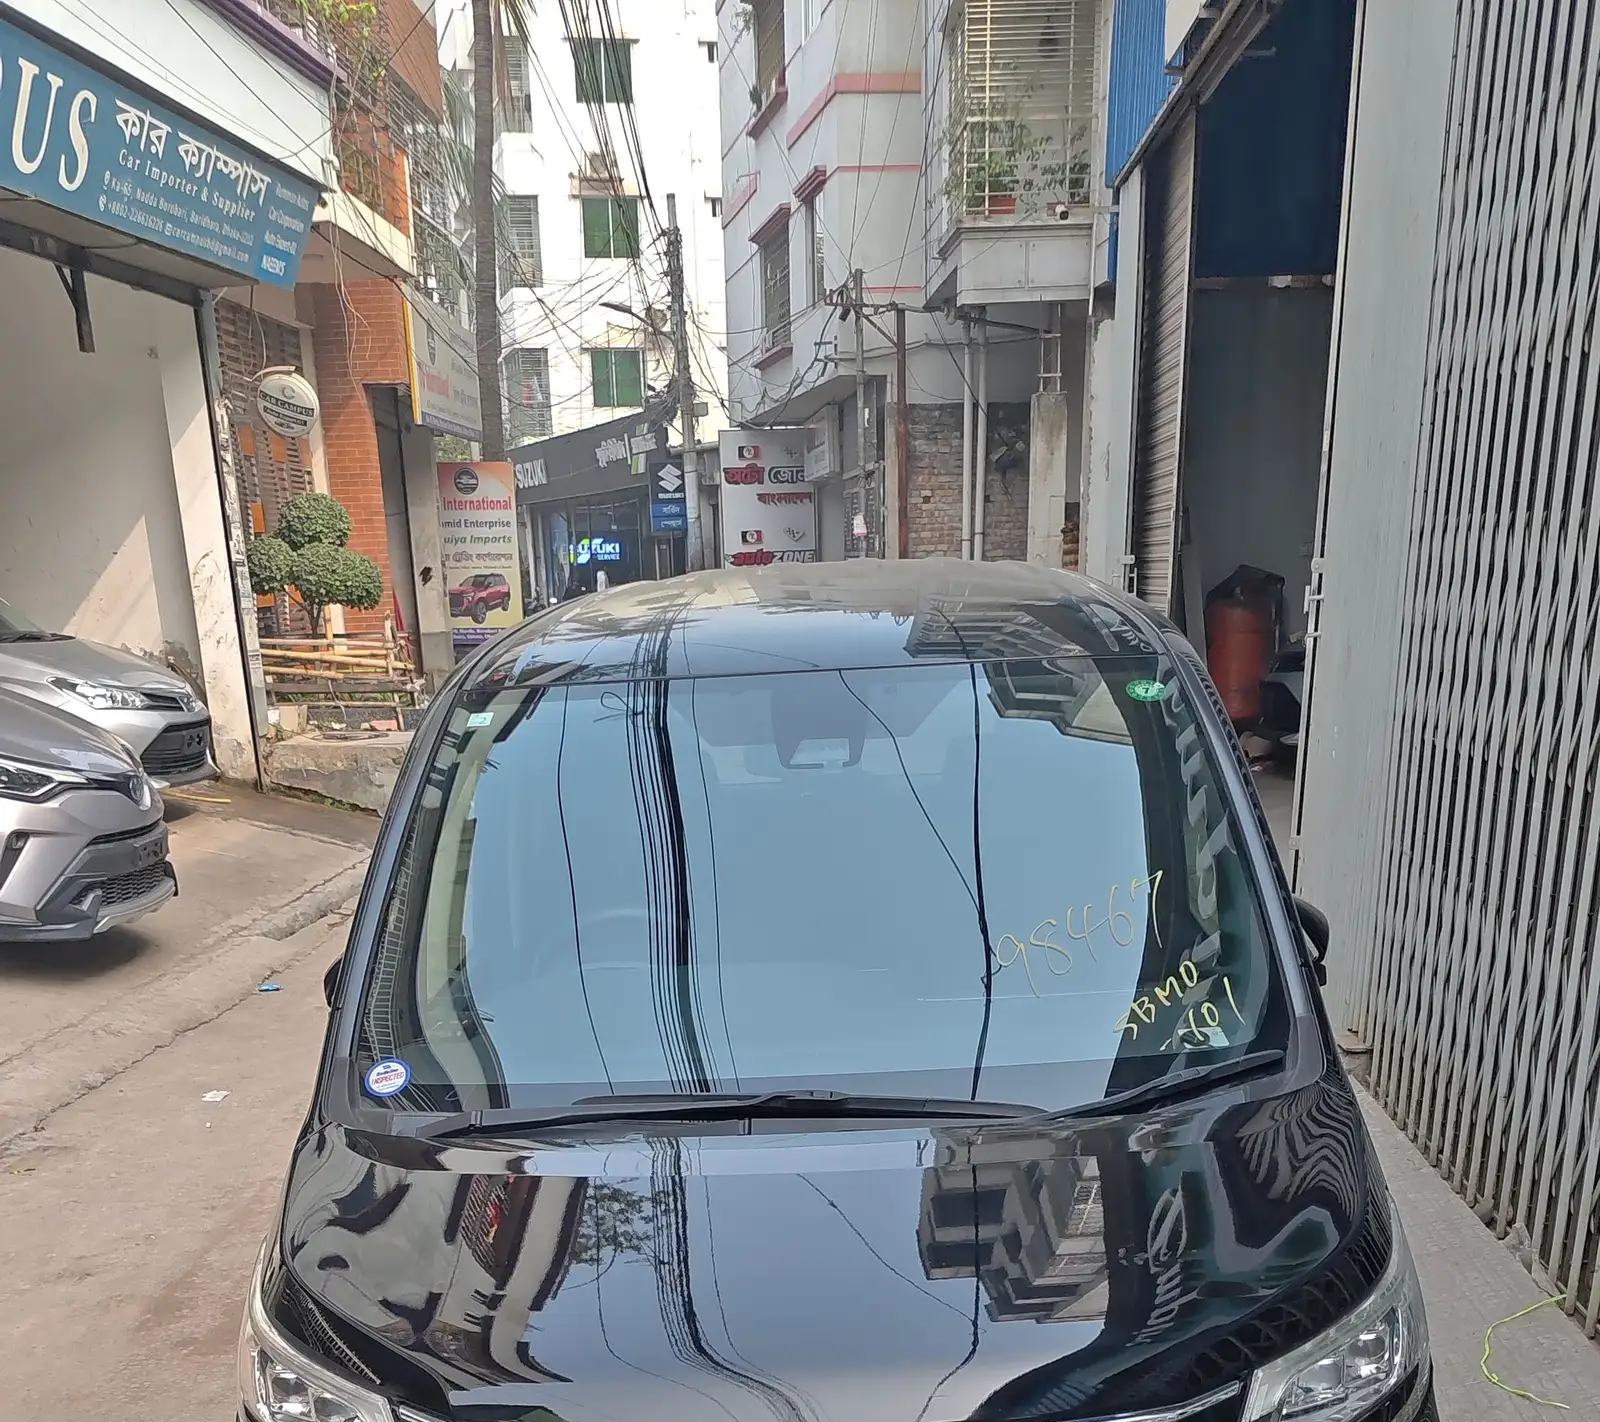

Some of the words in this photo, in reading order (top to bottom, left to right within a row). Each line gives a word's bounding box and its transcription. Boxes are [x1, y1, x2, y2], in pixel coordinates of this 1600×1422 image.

[0, 56, 97, 192] US
[115, 98, 172, 160] কার
[177, 131, 272, 208] ক্যাম্পাস
[119, 149, 140, 172] Car
[145, 160, 198, 198] Importer
[201, 186, 209, 203] &
[211, 191, 256, 222] Supplier
[136, 187, 158, 208] Nadda
[260, 391, 277, 405] CAR
[277, 400, 314, 417] CAMPUS
[515, 459, 548, 489] SUZUKI
[723, 463, 765, 485] অটো
[443, 496, 512, 511] International
[464, 518, 511, 531] Enterprise
[469, 534, 512, 546] Imports
[997, 870, 1164, 998] 98467
